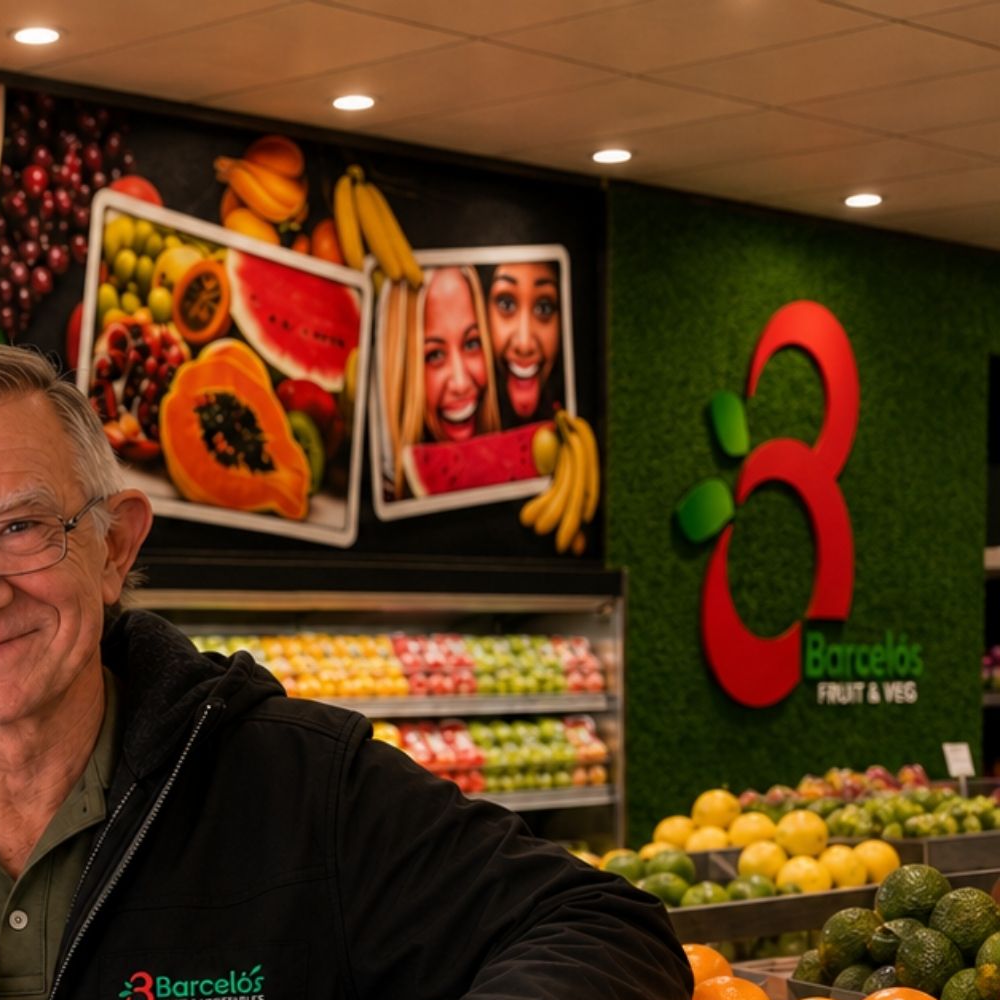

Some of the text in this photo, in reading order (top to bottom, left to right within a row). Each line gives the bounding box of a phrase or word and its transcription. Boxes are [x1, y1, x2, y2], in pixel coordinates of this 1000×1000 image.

[816, 680, 918, 705] FRUIT & VEG
